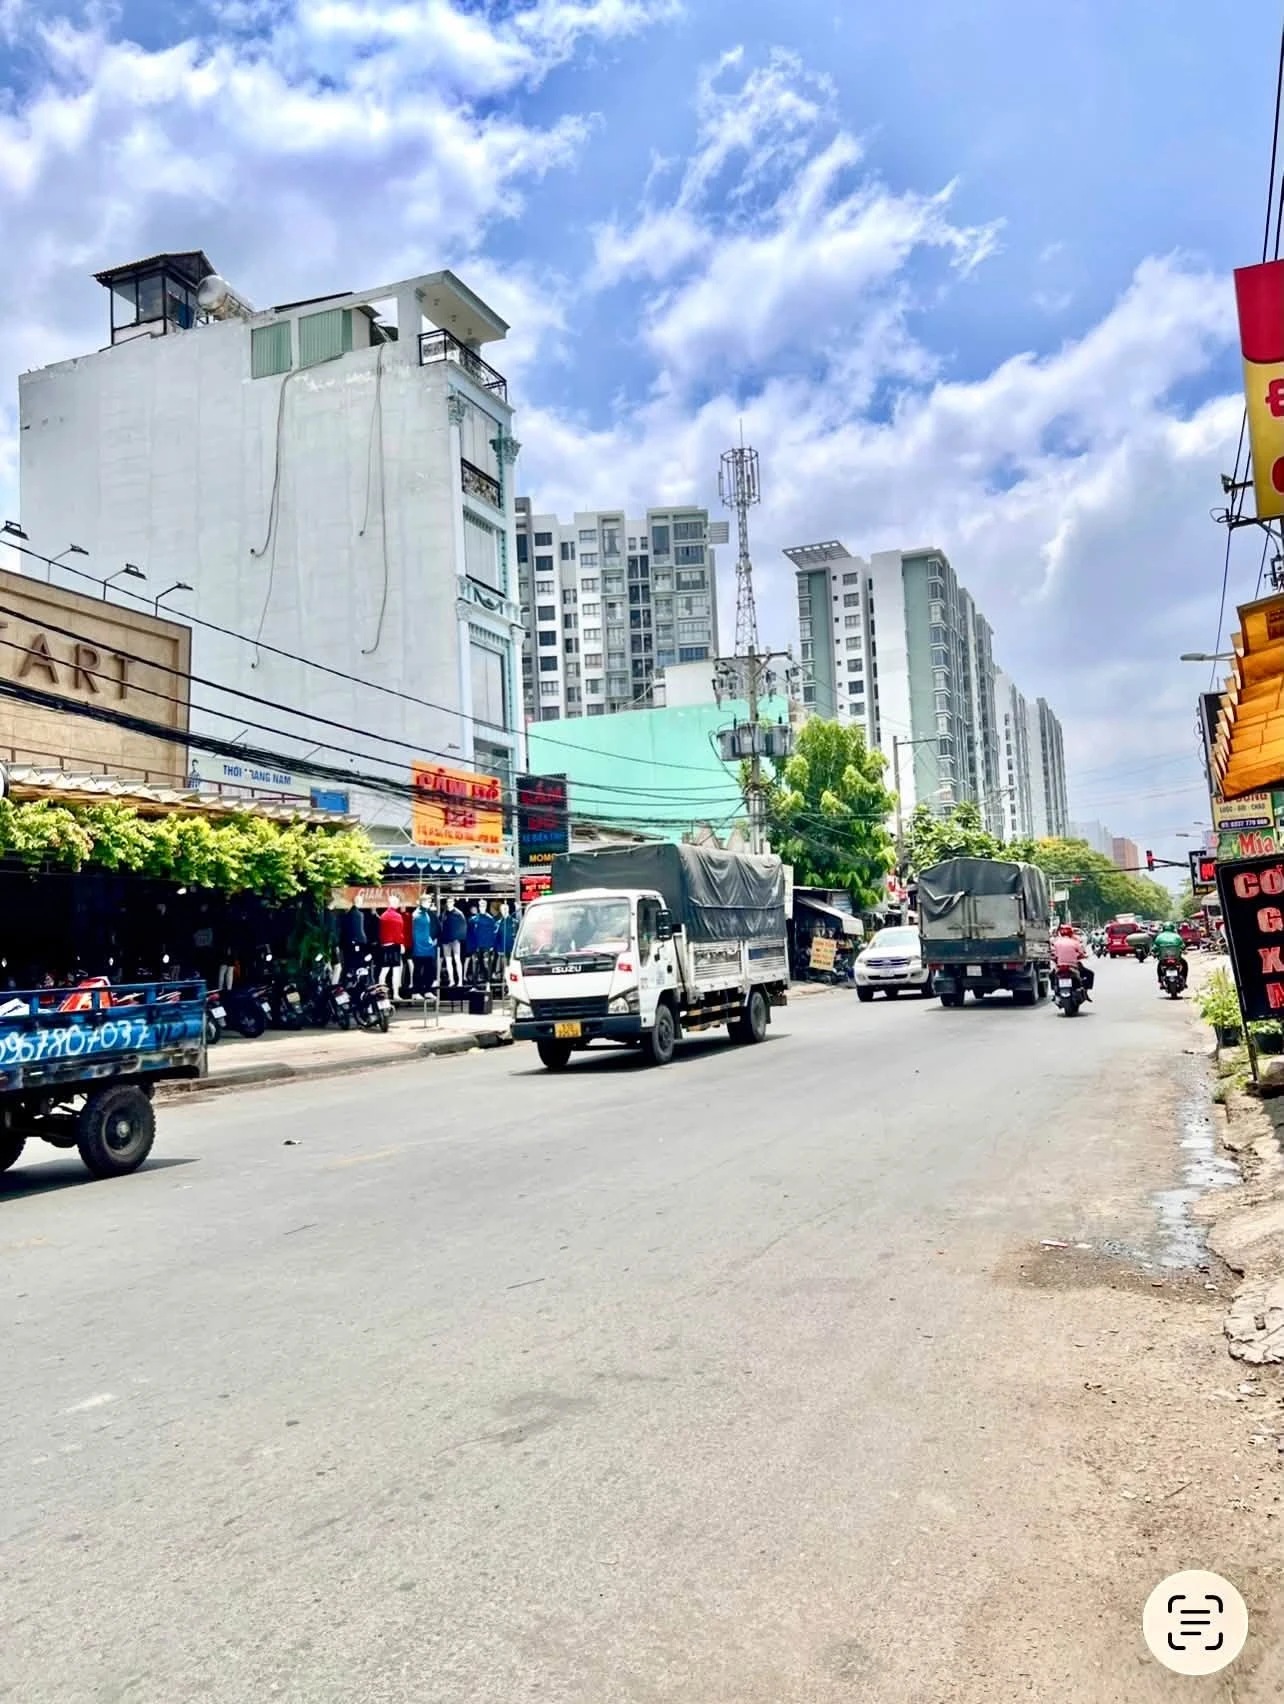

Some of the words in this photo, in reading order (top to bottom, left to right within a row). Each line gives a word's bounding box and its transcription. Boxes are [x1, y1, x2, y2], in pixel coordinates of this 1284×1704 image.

[0, 621, 136, 699] ART
[272, 773, 292, 785] NAM
[1239, 831, 1275, 857] Mía
[551, 965, 582, 974] ISUZU
